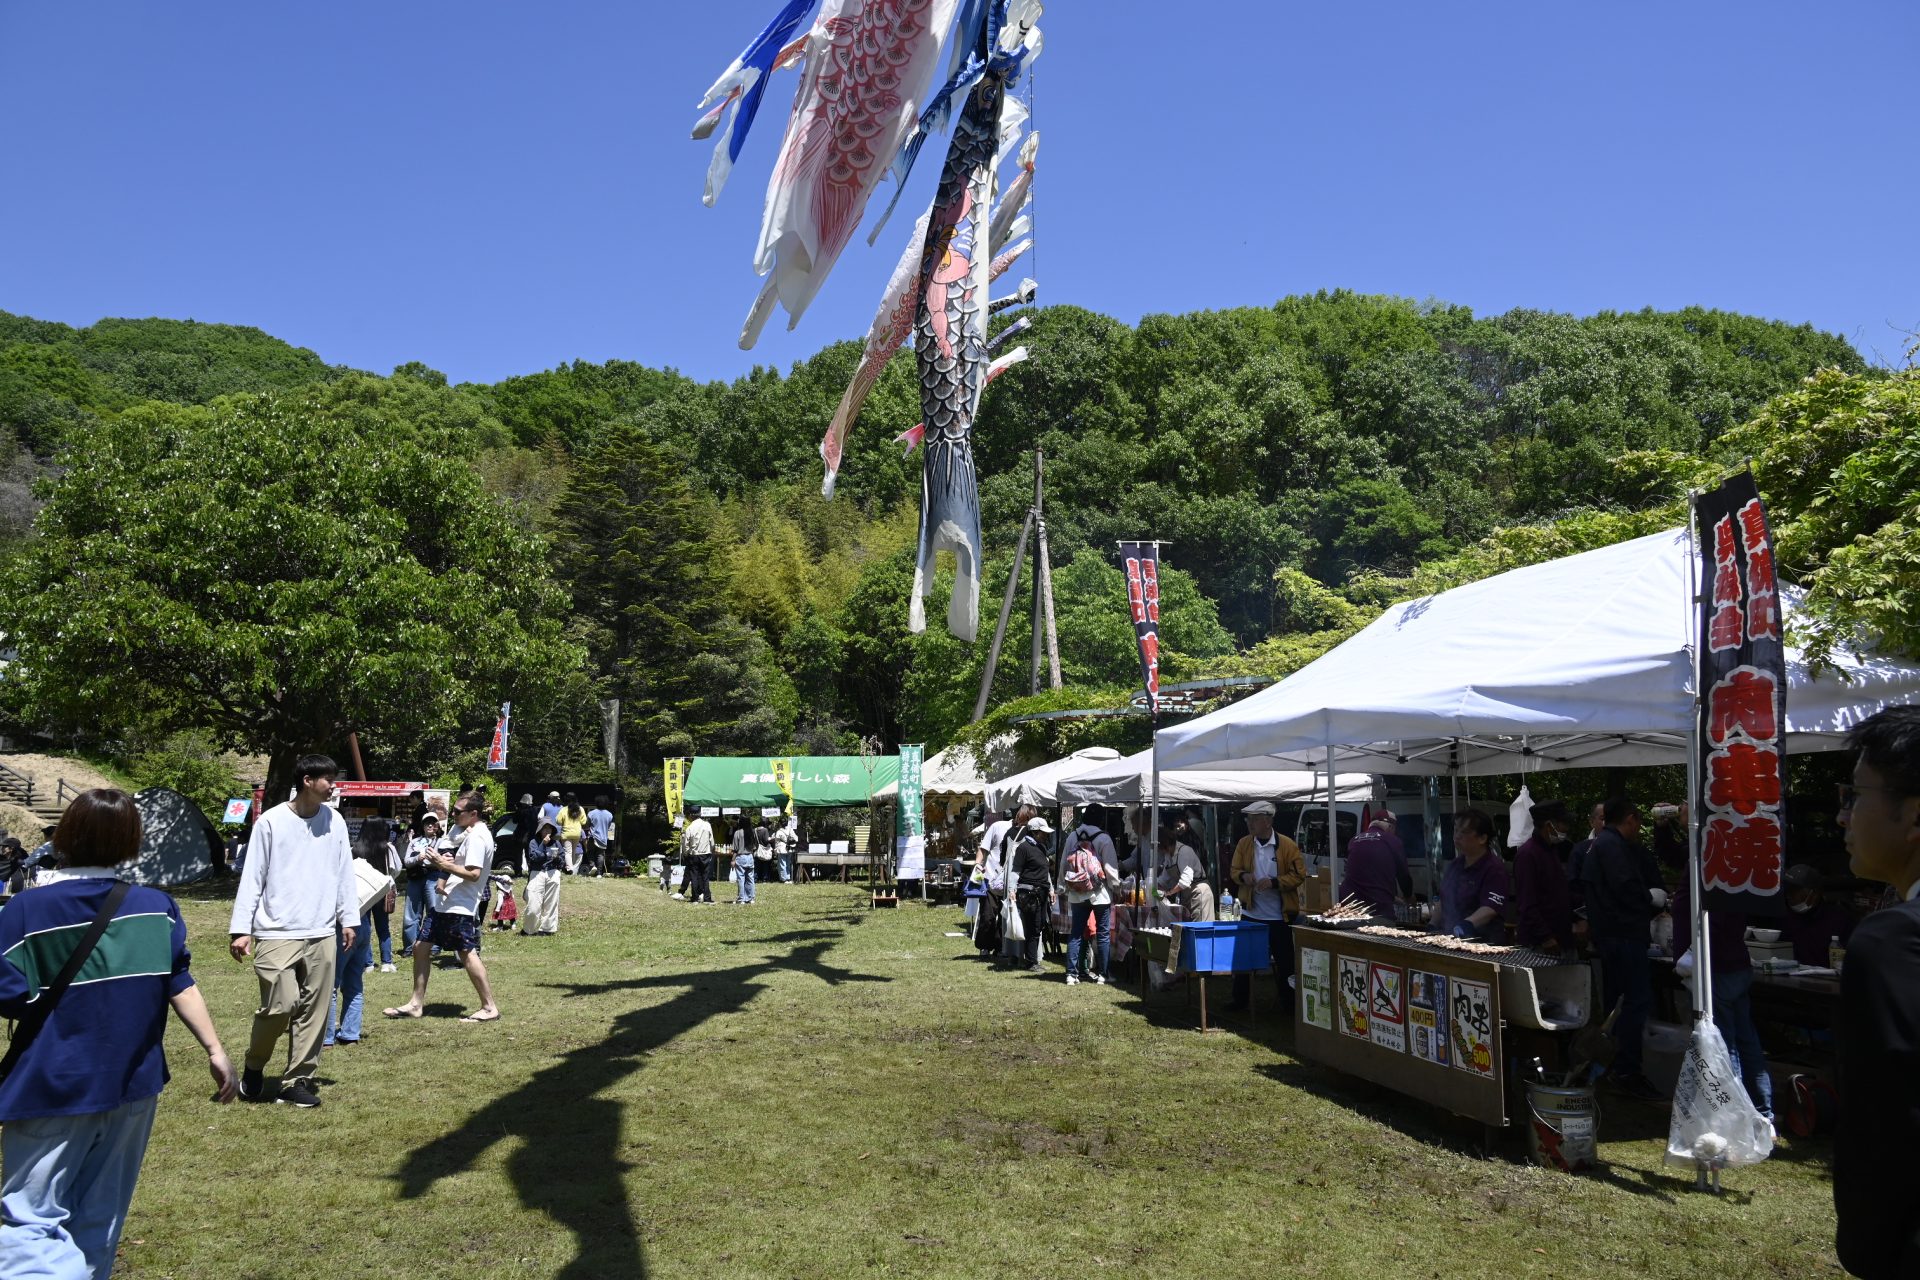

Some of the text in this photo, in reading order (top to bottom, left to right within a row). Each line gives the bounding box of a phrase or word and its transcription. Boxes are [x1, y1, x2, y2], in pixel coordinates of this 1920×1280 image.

[1736, 498, 1777, 642] 真備町
[740, 772, 850, 784] 真備しい森
[1701, 665, 1780, 896] 肉串焼
[1340, 960, 1368, 1008] 肉串
[1354, 1016, 1367, 1030] 500
[1411, 1012, 1433, 1026] 400円
[1454, 984, 1490, 1040] 肉串
[1473, 1050, 1489, 1065] 500
